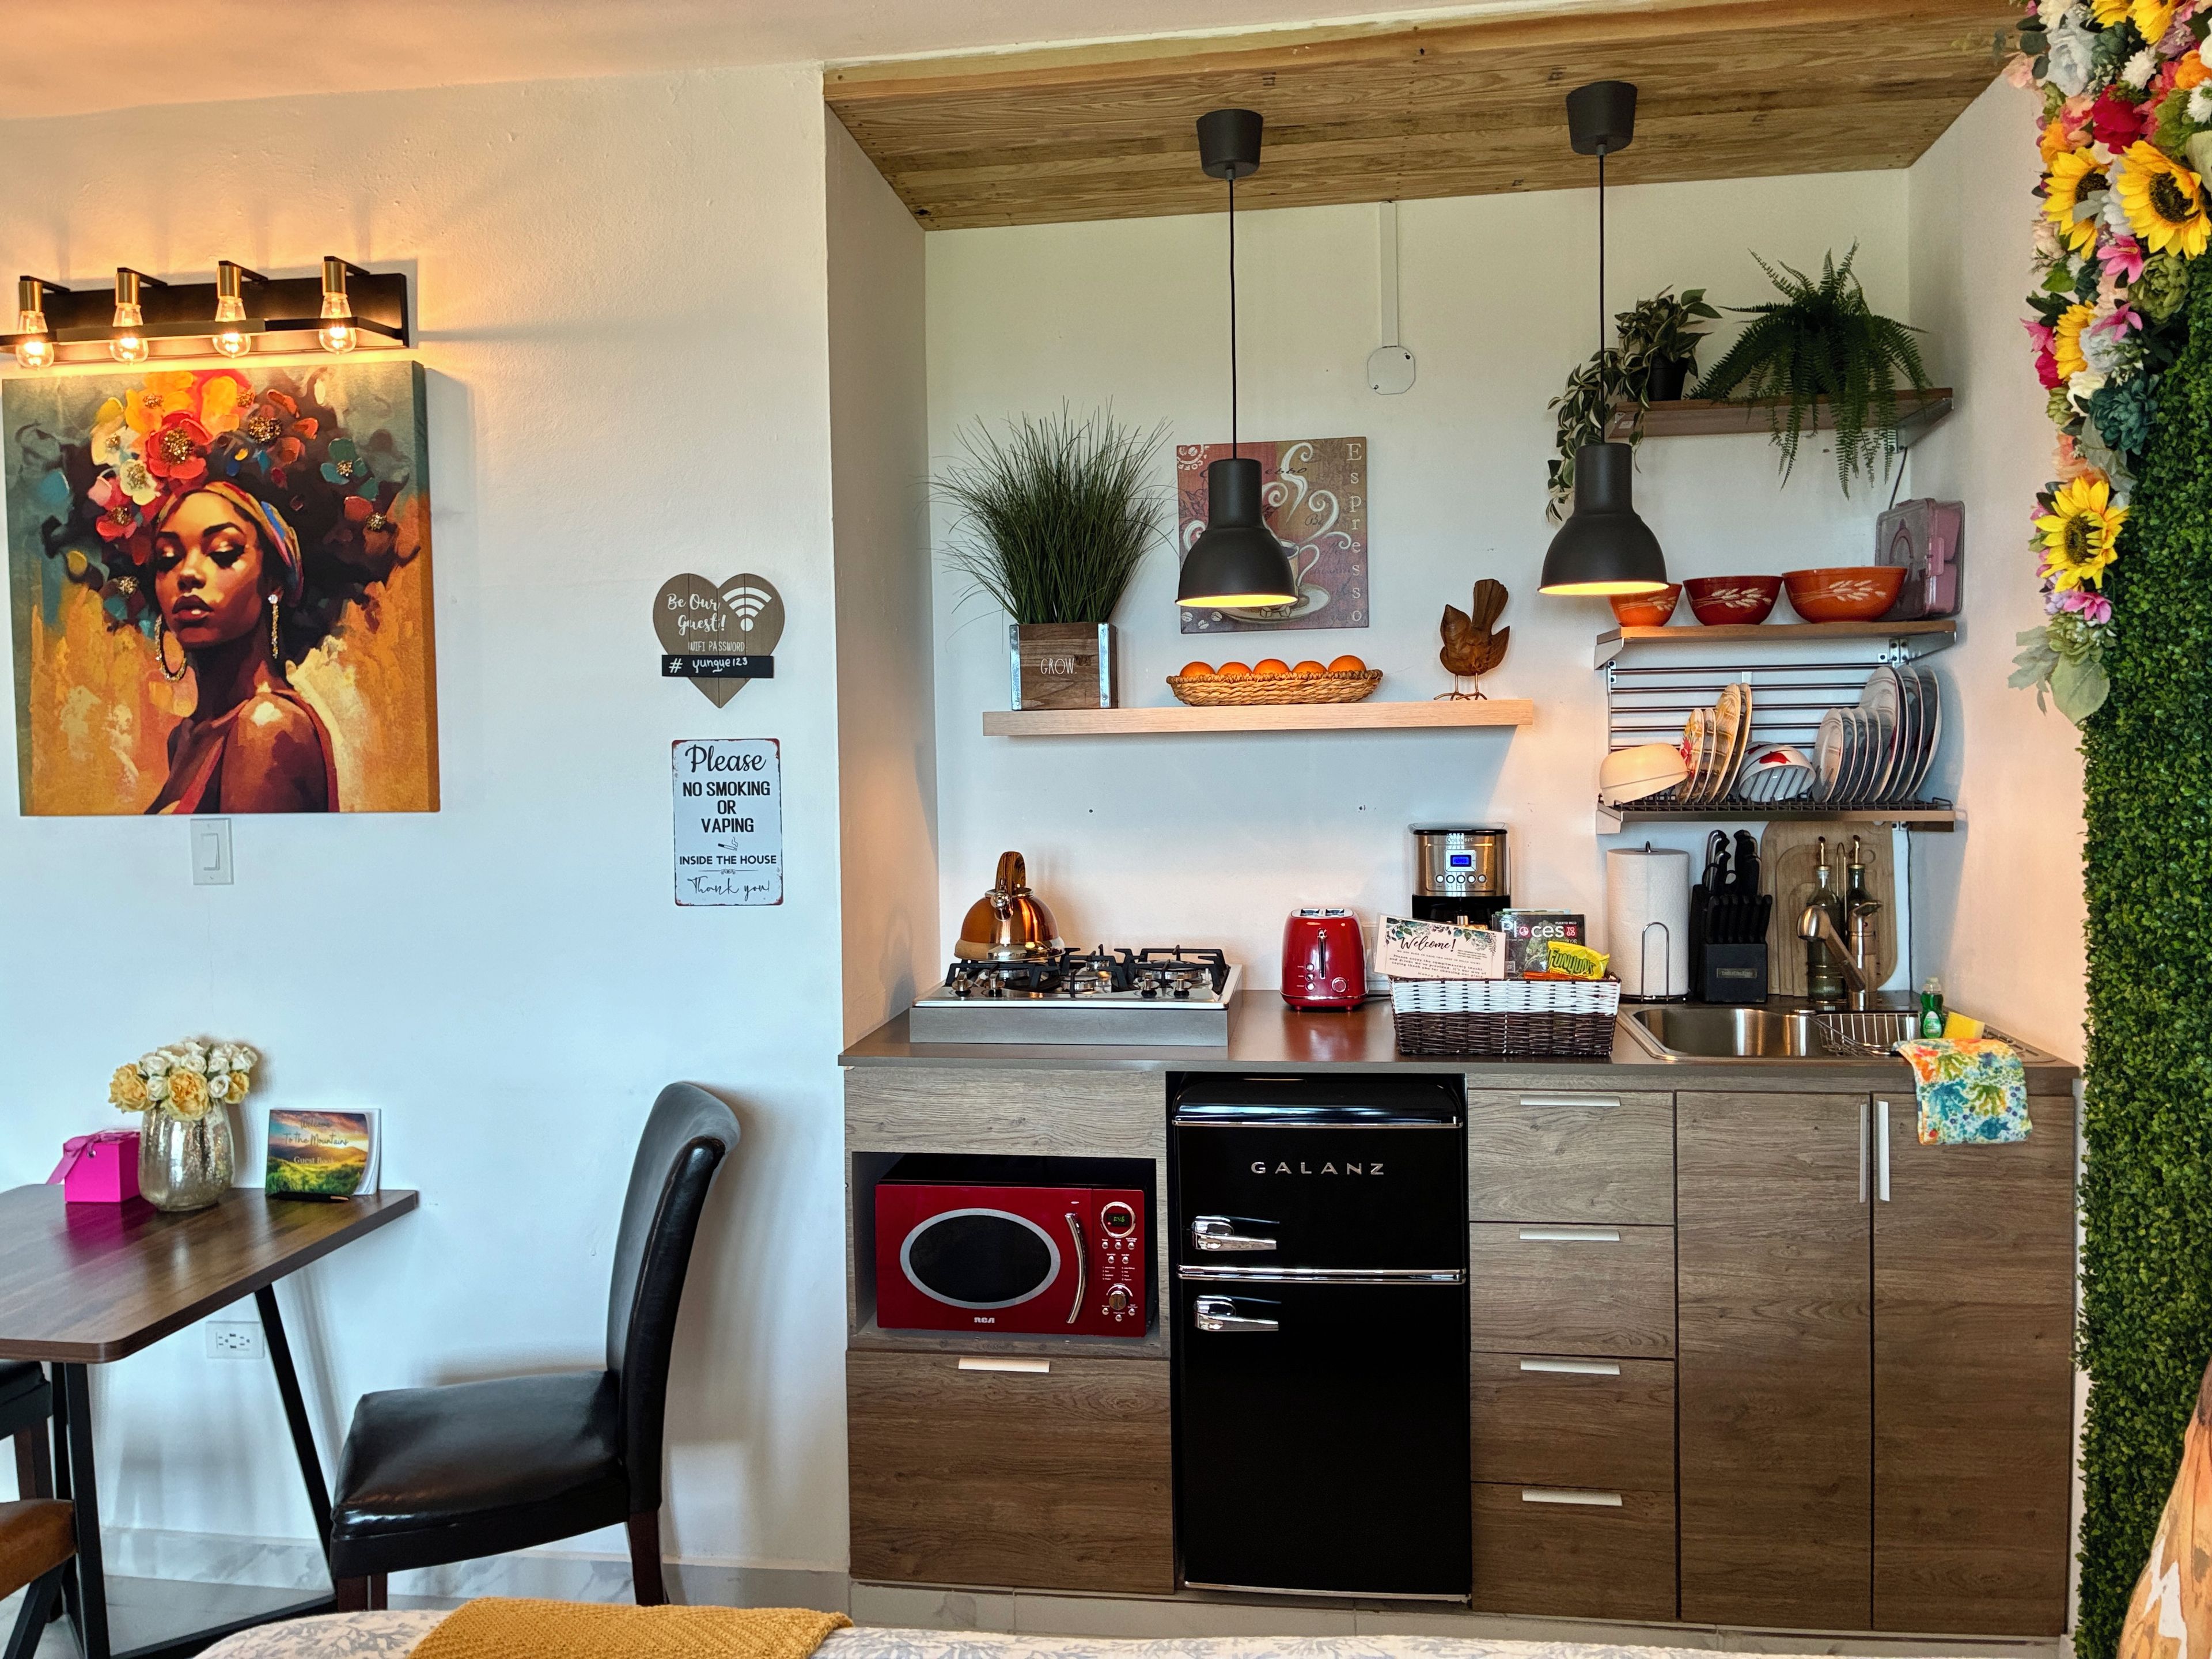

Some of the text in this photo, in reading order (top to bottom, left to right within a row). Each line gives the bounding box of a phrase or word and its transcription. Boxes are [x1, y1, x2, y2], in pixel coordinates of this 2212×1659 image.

[1346, 443, 1362, 622] Espresso
[667, 593, 720, 611] Be Our
[677, 613, 726, 636] Guest!
[688, 641, 745, 652] WIFI PASSWORD
[685, 744, 767, 772] Please
[683, 781, 770, 797] NO SMOKING
[717, 800, 736, 815] OR
[701, 818, 754, 833] VAPING
[680, 855, 777, 865] INSIDE THE HOUSE
[687, 876, 770, 902] Thank you!
[1398, 935, 1456, 952] Welcome!
[1251, 1161, 1384, 1176] GALANZ
